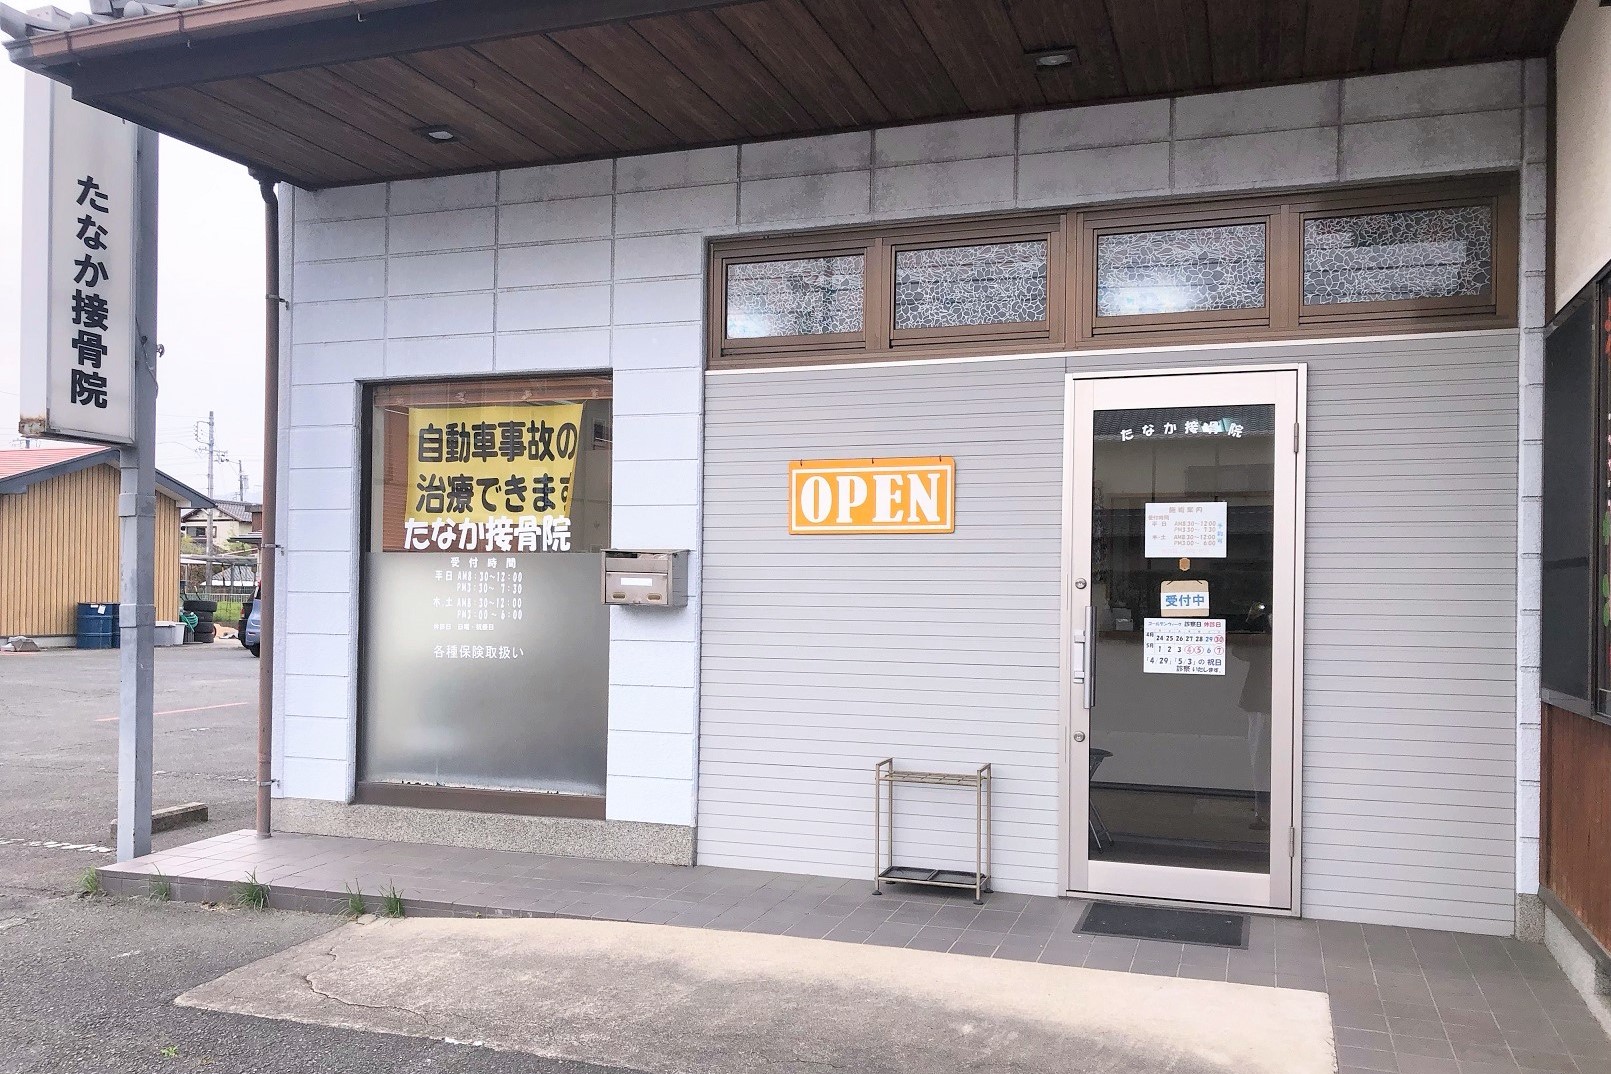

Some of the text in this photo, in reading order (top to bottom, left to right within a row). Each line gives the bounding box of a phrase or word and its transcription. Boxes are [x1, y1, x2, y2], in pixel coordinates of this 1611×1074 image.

[71, 175, 110, 409] たなか接骨院
[418, 420, 578, 463] 自動車事故の
[1120, 420, 1244, 442] たなか接骨院
[800, 473, 941, 523] OPEN
[404, 515, 571, 552] たなか接骨院
[450, 556, 517, 569] 受付時間
[435, 570, 453, 581] 平日
[1165, 594, 1205, 607] 受付中
[433, 644, 524, 660] 各種保険取扱い
